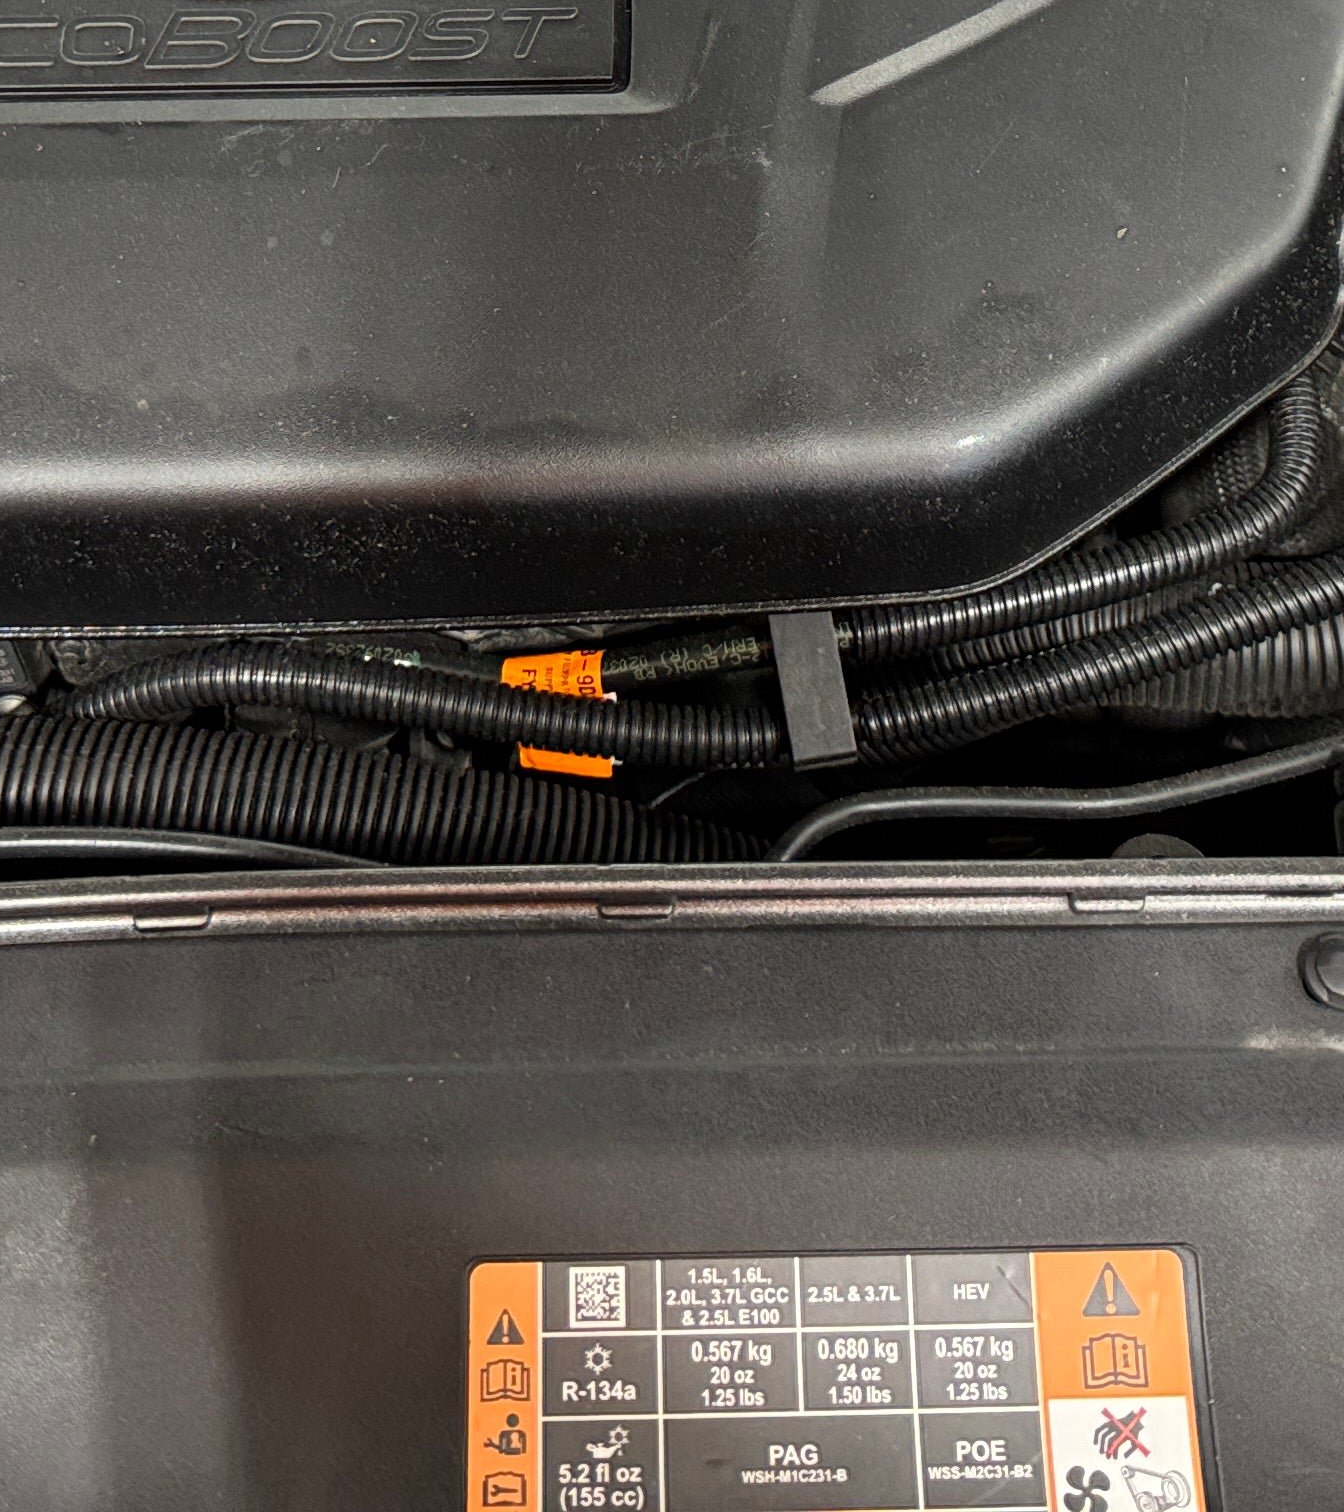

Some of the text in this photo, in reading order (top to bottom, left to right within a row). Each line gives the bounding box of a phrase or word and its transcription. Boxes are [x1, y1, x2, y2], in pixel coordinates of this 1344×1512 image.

[687, 1267, 772, 1285] 1.5L, 1.6L,
[666, 1287, 790, 1307] 2.0L, 3.7L GCC
[807, 1285, 901, 1303] 2.5L & 3.7L
[953, 1283, 990, 1300] HEV
[681, 1309, 780, 1326] & 2.5L E100
[691, 1340, 773, 1366] 0.567 kg
[818, 1338, 899, 1364] 0.680 kg
[934, 1336, 1014, 1362] 0.567 kg
[710, 1366, 754, 1384] 20 oz
[837, 1364, 882, 1382] 24 oz
[954, 1361, 998, 1379] 20 oz
[561, 1381, 637, 1402] R-134a
[702, 1388, 765, 1407] 1.25 lbs
[828, 1386, 892, 1404] 1.50 lbs
[946, 1382, 1008, 1401] 1.25 lbs
[768, 1444, 819, 1466] PAG
[955, 1440, 1007, 1462] POE
[558, 1463, 643, 1483] 5.2 fl oz
[741, 1468, 849, 1485] WSH-M1C231-B
[927, 1464, 1033, 1480] WSS-M2C31-B2
[560, 1486, 645, 1512] (155 cc)
